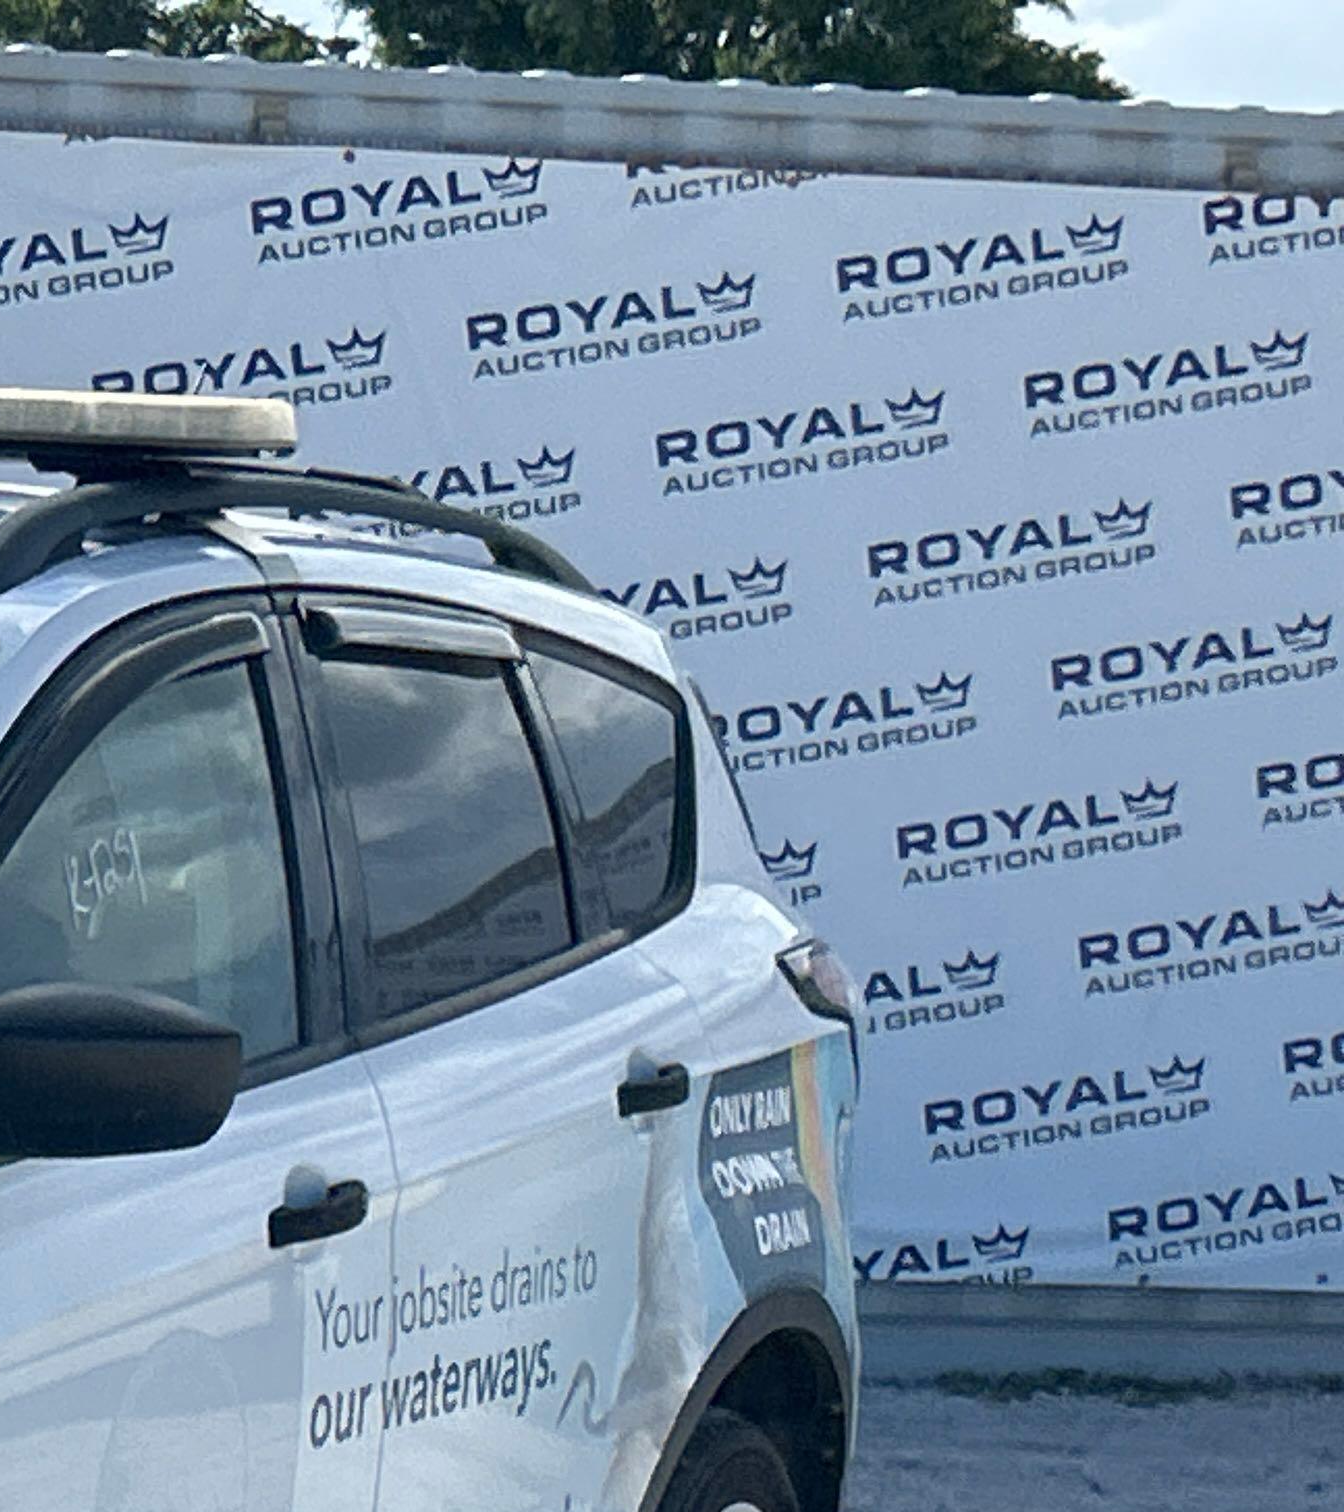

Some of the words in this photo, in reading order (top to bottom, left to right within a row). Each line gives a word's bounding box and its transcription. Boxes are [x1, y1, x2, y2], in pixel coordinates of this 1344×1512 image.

[249, 170, 483, 235] ROYAL
[258, 223, 416, 263] AUCTION
[424, 202, 549, 239] GROUP
[836, 229, 1064, 293] ROYAL
[1209, 226, 1344, 265] AUCTIO
[48, 260, 174, 297] GROUP
[844, 281, 998, 321] AUCTION
[1006, 260, 1128, 296] GROUP
[465, 286, 696, 350] ROYAL
[473, 338, 630, 378] AUCTION
[638, 317, 761, 353] GROUP
[1022, 344, 1249, 408] ROYAL
[1030, 396, 1183, 436] AUCTION
[1191, 374, 1312, 411] GROUP
[655, 403, 885, 467] ROYAL
[663, 455, 819, 495] AUCTION
[827, 433, 949, 470] GROUP
[478, 492, 581, 520] ROUP
[1237, 511, 1344, 547] AUCTI
[866, 514, 1093, 578] ROYAL
[874, 565, 1027, 606] AUCTION
[1035, 544, 1156, 581] GROUP
[600, 573, 728, 616] YAL
[670, 603, 792, 640] GROUP
[1050, 627, 1275, 692] ROYAL
[1058, 678, 1210, 719] AUCTION
[1218, 657, 1338, 693] GROUP
[727, 738, 848, 774] CTION
[856, 716, 977, 752] GROUP
[894, 794, 1119, 859] ROYAL
[902, 845, 1054, 886] AUCTION
[1062, 823, 1182, 860] GROUP
[1078, 904, 1302, 969] ROYAL
[1086, 955, 1237, 996] AUCTION
[1245, 937, 1340, 970] GROU
[884, 994, 1004, 1031] GROUP
[710, 1092, 753, 1138] ONLY
[923, 1071, 1147, 1135] ROYAL
[931, 1121, 1082, 1162] AUCTION
[1090, 1099, 1209, 1135] GROUP
[712, 1153, 784, 1198] DOWN
[753, 1208, 812, 1255] DRAIN
[1106, 1177, 1328, 1241] ROYAL
[853, 1239, 971, 1283] YAL
[1114, 1227, 1264, 1268] AUCTION
[1271, 1213, 1342, 1241] GRO
[315, 1286, 384, 1352] Your
[387, 1263, 483, 1357] jobsite
[490, 1247, 567, 1314] drains
[572, 1243, 598, 1293] to
[309, 1382, 373, 1450] our
[380, 1338, 557, 1431] waterways.
